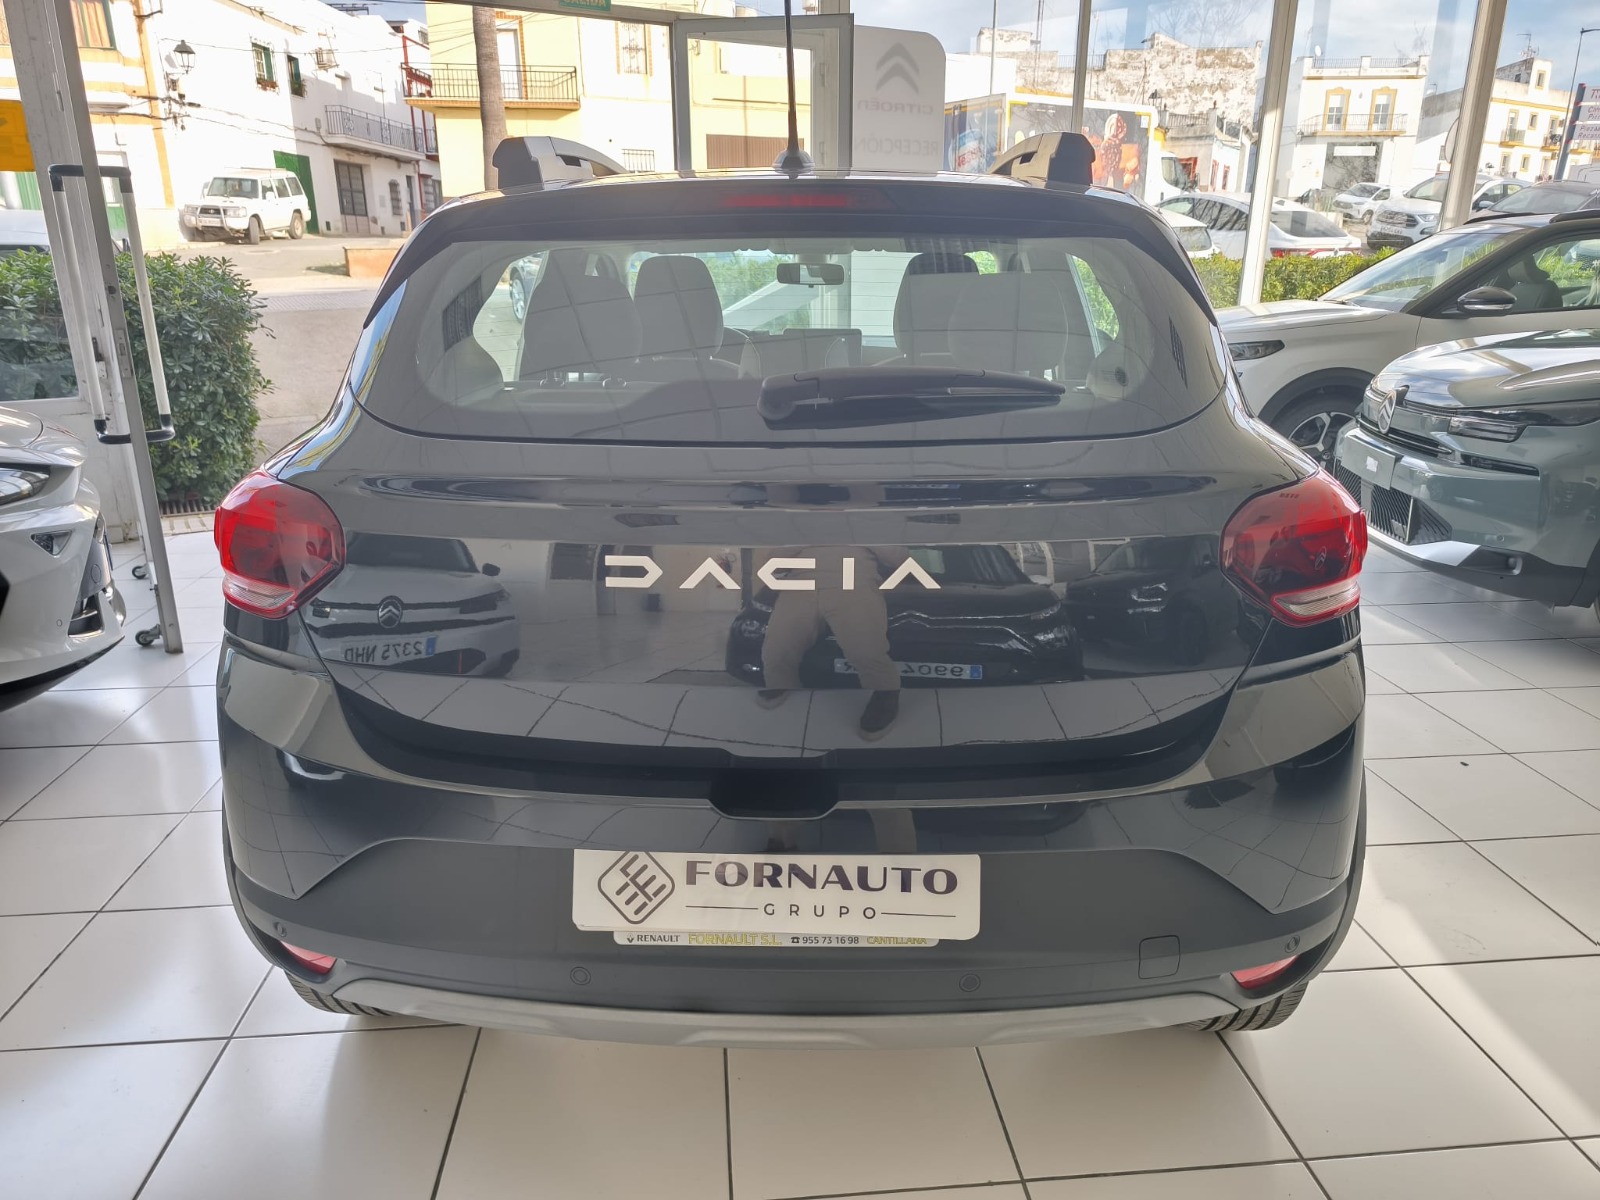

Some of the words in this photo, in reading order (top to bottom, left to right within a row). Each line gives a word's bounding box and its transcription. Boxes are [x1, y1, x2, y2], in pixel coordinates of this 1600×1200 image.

[605, 555, 942, 590] DACIA
[685, 860, 958, 895] FORNAUTO
[763, 903, 876, 919] GRUPO
[636, 934, 680, 942] RENAULT
[688, 933, 757, 944] FORNAULT
[760, 934, 782, 945] S.L.
[802, 936, 819, 944] 955
[822, 936, 832, 944] 73
[867, 936, 927, 945] CANTILLANA
